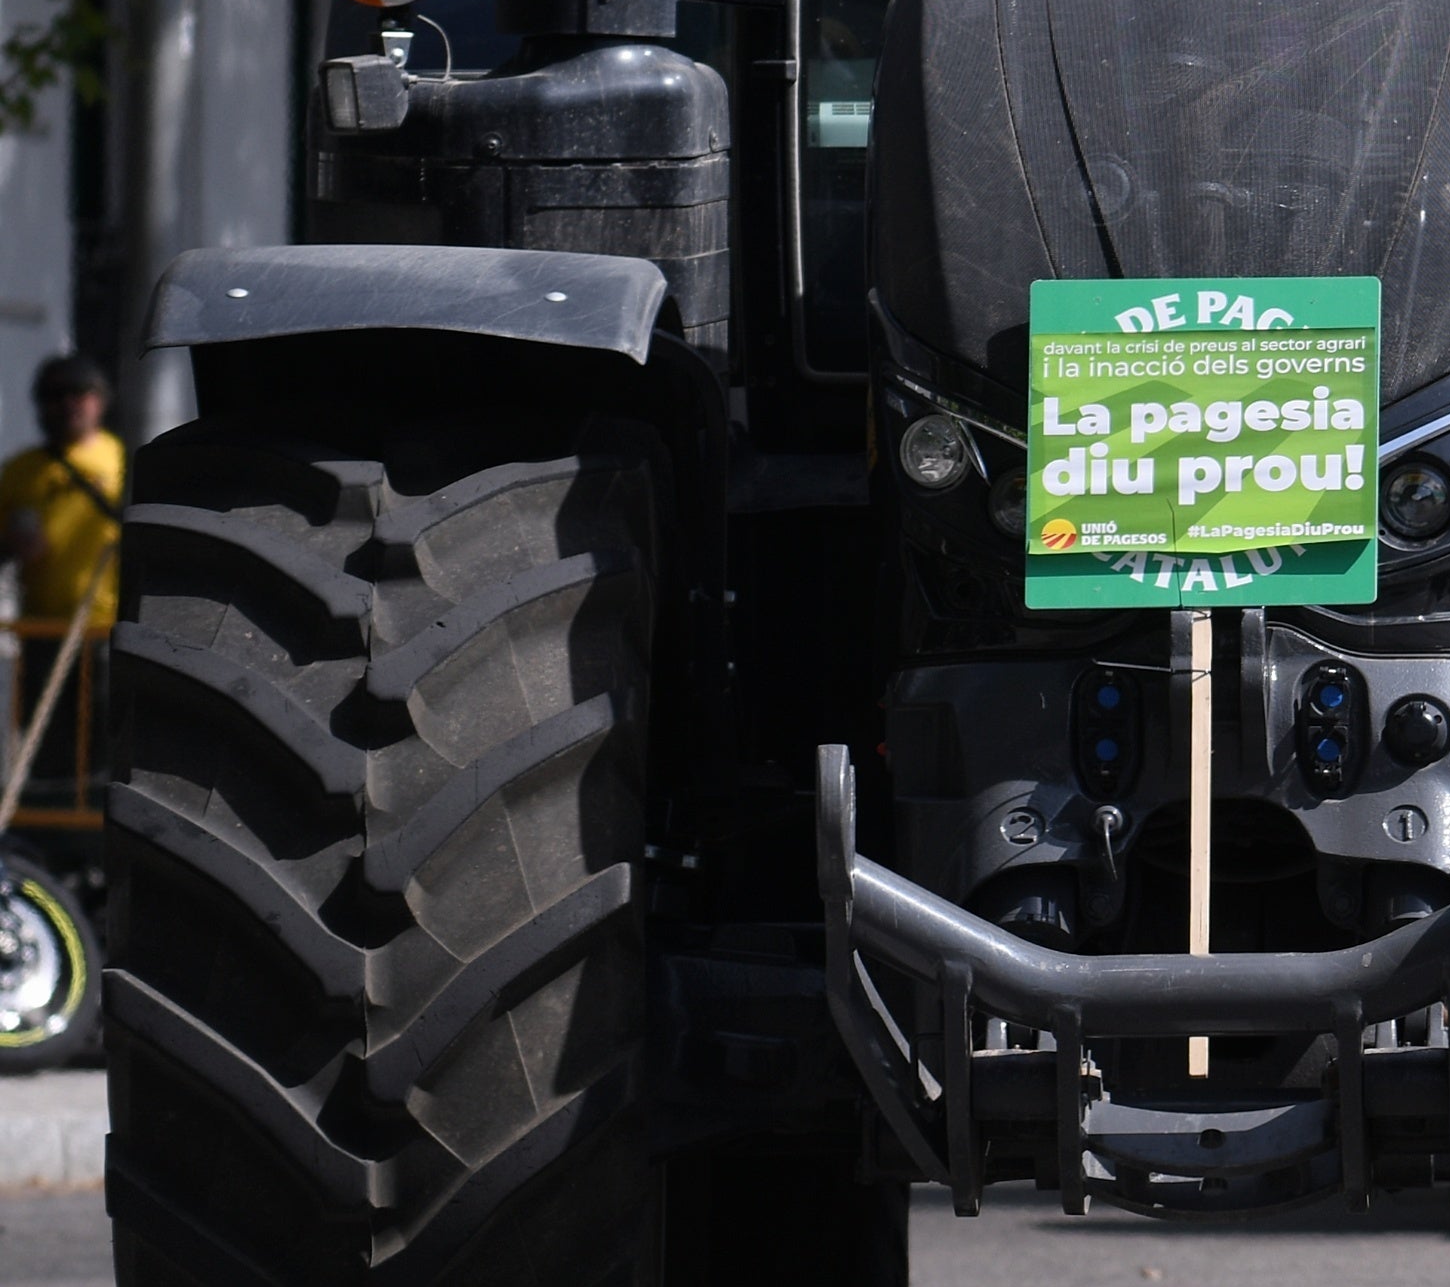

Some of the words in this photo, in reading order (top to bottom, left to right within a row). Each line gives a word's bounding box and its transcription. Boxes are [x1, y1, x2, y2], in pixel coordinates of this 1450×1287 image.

[1114, 293, 1188, 335] DE
[1043, 341, 1102, 356] davant
[1106, 340, 1120, 355] la
[1125, 339, 1159, 355] crisi
[1163, 339, 1185, 354] de
[1190, 340, 1237, 356] preus
[1241, 337, 1256, 353] al
[1259, 338, 1312, 352] sector
[1316, 335, 1367, 353] agrari
[1043, 357, 1050, 378] i
[1058, 357, 1080, 378] la
[1089, 354, 1186, 377] inacció
[1193, 354, 1250, 376] dels
[1256, 354, 1367, 379] governs
[1042, 397, 1111, 436] La
[1130, 385, 1366, 444] pagesia
[1041, 442, 1155, 496] diu
[1177, 443, 1366, 506] prou!
[1080, 519, 1118, 535] UNIÓ
[1080, 534, 1106, 547] DE
[1107, 532, 1167, 547] PAGESOS
[1187, 522, 1366, 539] #LaPagesiaDiuProu
[1010, 812, 1038, 845] 2
